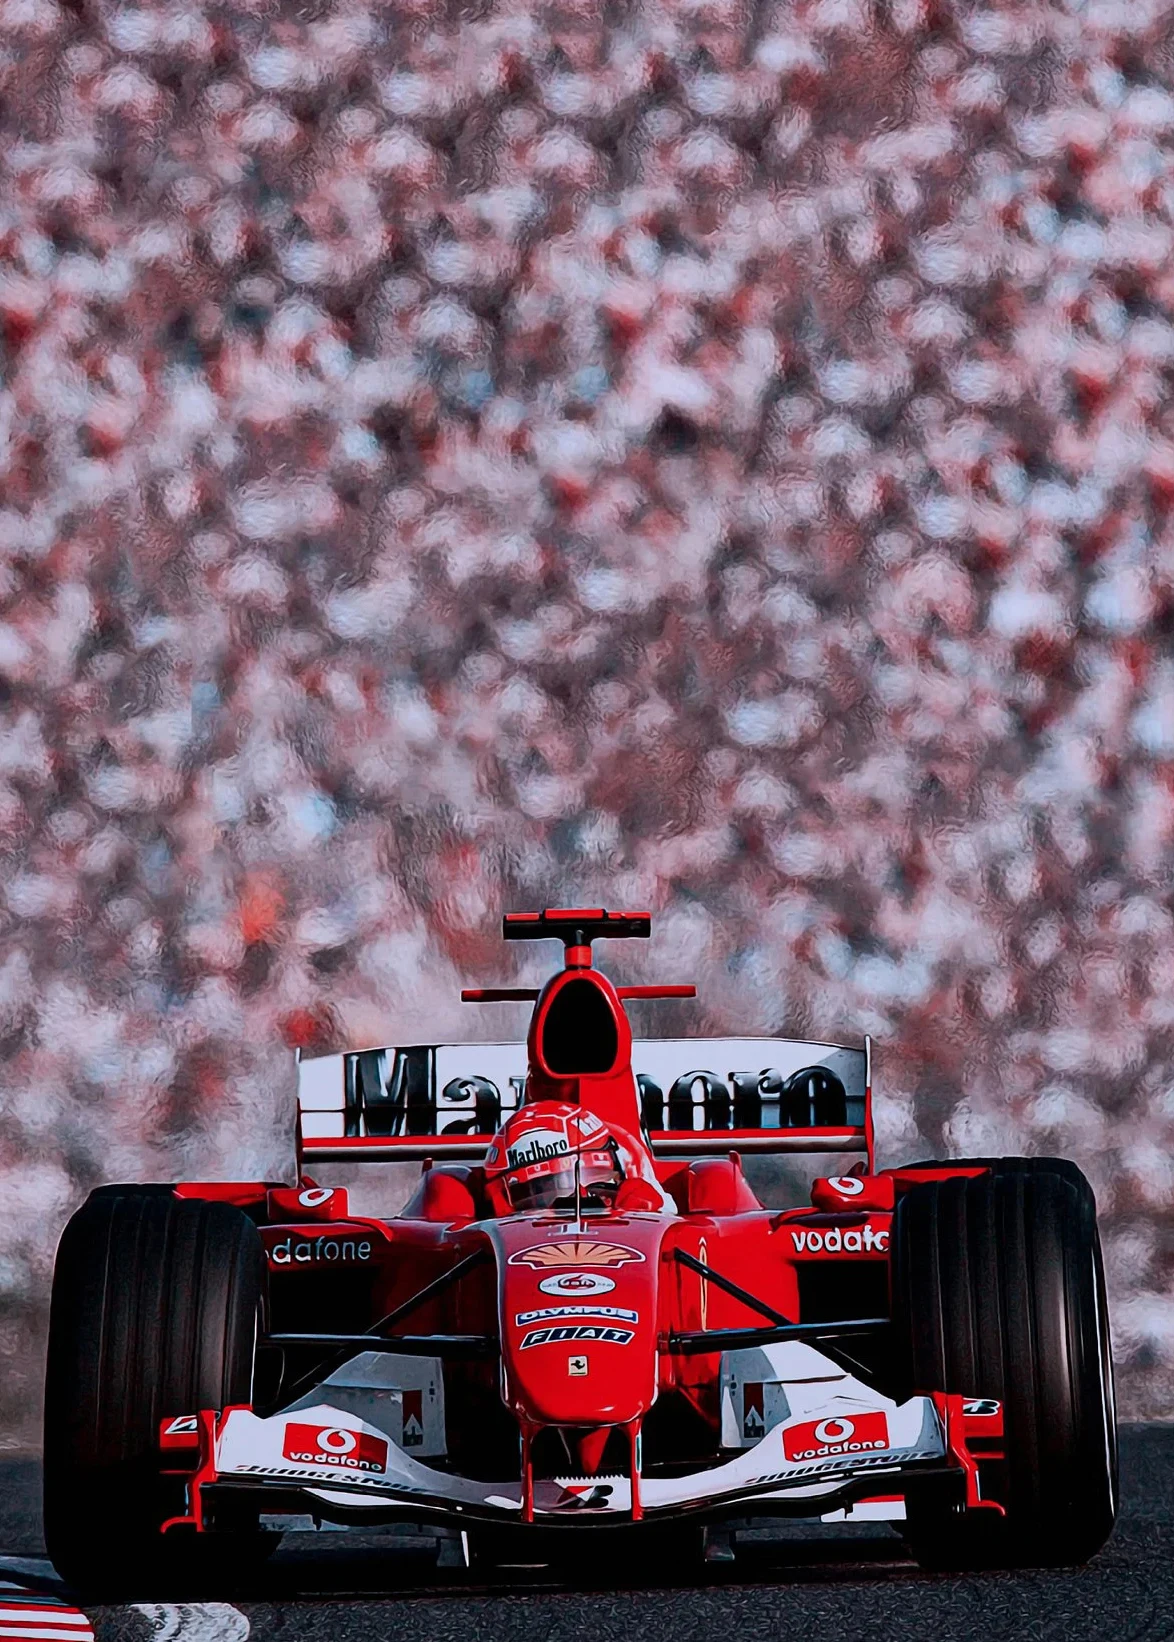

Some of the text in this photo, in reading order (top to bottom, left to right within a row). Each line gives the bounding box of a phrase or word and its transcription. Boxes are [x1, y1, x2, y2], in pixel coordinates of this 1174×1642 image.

[342, 1045, 847, 1138] Maoro
[507, 1138, 568, 1168] Marlboro
[265, 1235, 371, 1263] dafone
[791, 1224, 890, 1252] vodafo
[519, 1306, 636, 1321] OLYMPUS
[528, 1327, 626, 1345] FIAT
[288, 1451, 384, 1472] vodafone
[793, 1438, 887, 1460] vodafone
